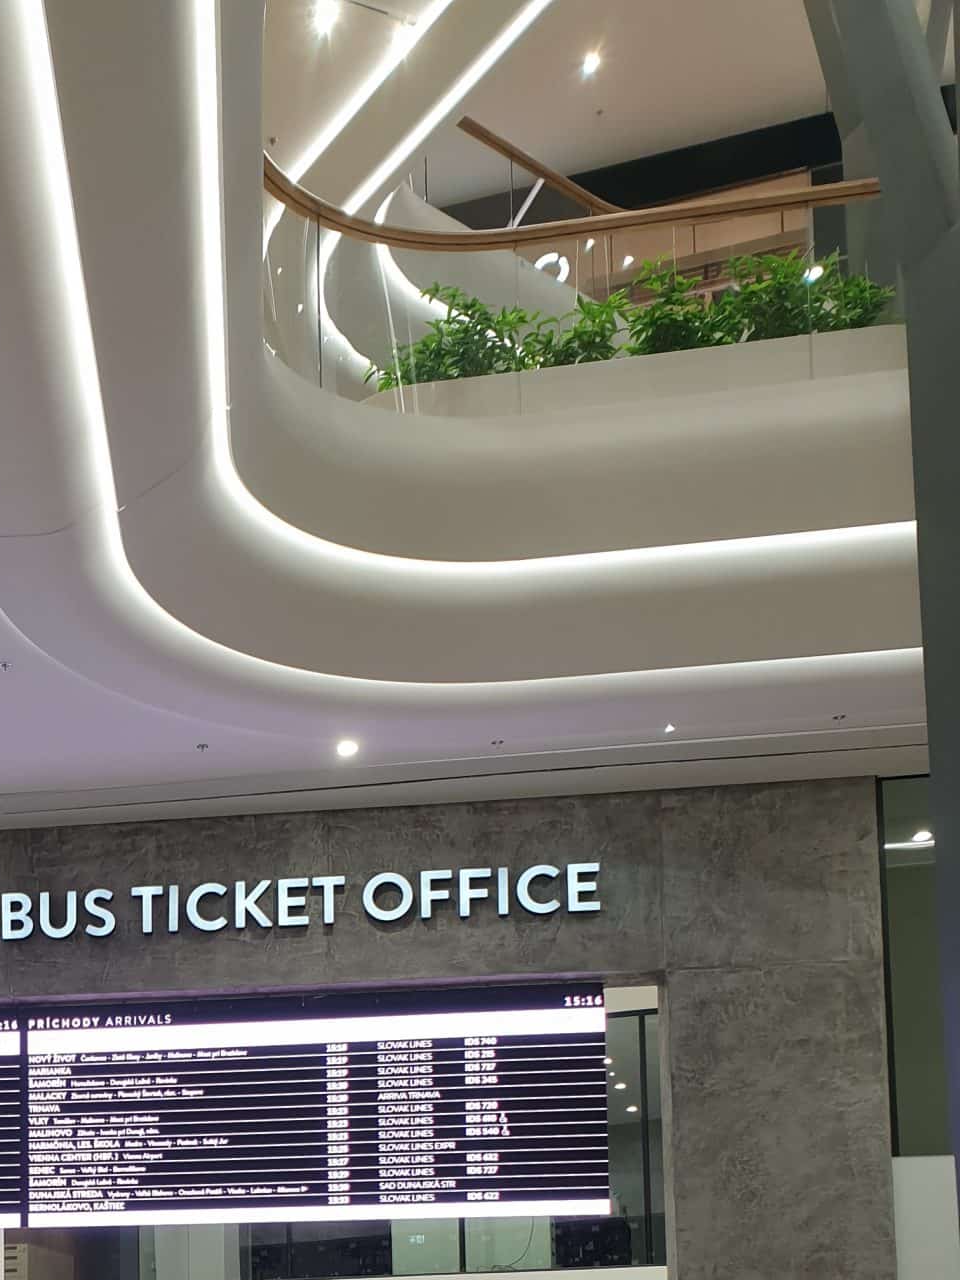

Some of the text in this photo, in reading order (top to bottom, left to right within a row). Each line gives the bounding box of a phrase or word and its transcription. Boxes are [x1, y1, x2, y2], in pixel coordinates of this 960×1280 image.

[0, 889, 116, 941] BUS
[131, 875, 345, 934] TICKET
[363, 862, 601, 922] OFFICE
[564, 995, 603, 1007] 15:16
[28, 1014, 172, 1030] PRÍCHODY ARRIVALS
[377, 1053, 433, 1062] SLOVAK LINES
[378, 1067, 409, 1075] SLOVAK
[378, 1104, 433, 1113] SLOVAK LINES
[378, 1117, 433, 1126] SLOVAK LINES
[378, 1130, 409, 1138] SLOVAK
[378, 1143, 410, 1151] SLOVAK
[379, 1155, 435, 1164] SLOVAK LINES
[379, 1168, 435, 1177] SLOVAK LINES
[412, 1194, 435, 1202] LINES
